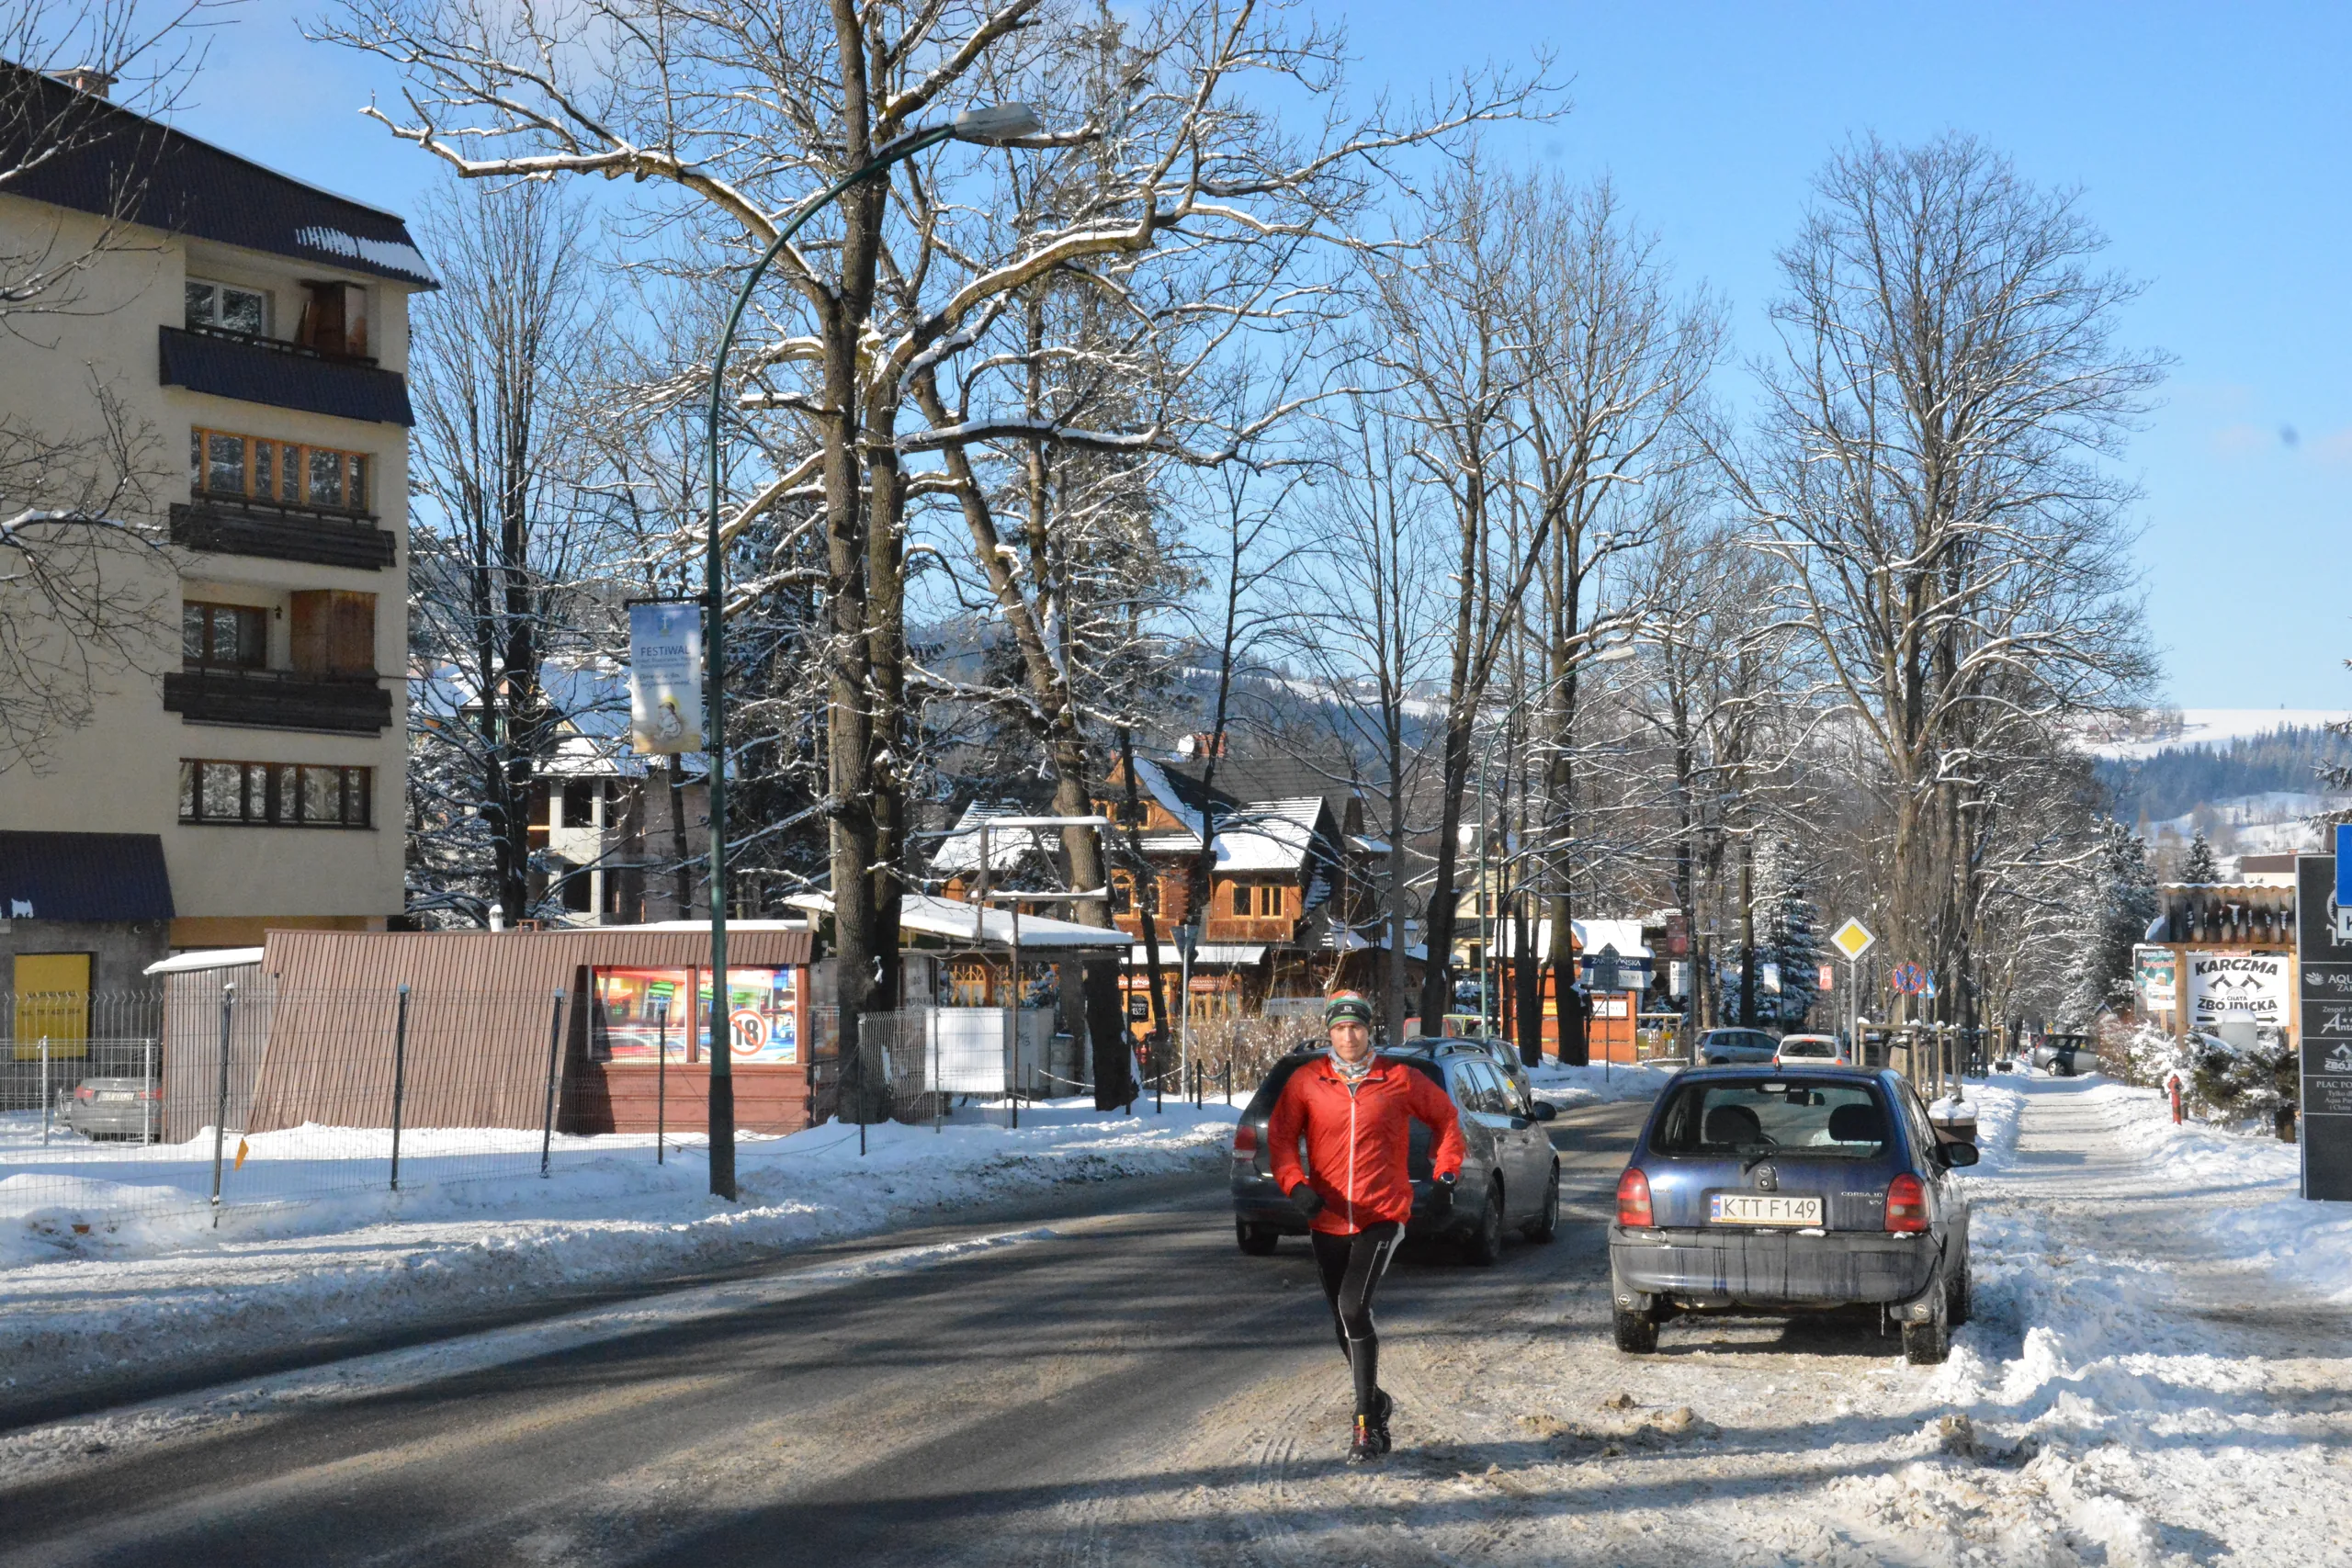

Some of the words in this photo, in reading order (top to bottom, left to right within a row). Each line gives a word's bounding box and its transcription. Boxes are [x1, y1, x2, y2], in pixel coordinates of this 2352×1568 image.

[640, 646, 691, 656] FESTIWAL
[2195, 959, 2278, 976] KARCZMA
[2198, 997, 2278, 1011] ZBÓJNICKA
[2323, 1006, 2346, 1014] Zespół
[732, 1020, 759, 1045] 18
[1724, 1198, 1762, 1217] KTT
[1770, 1199, 1816, 1218] F149
